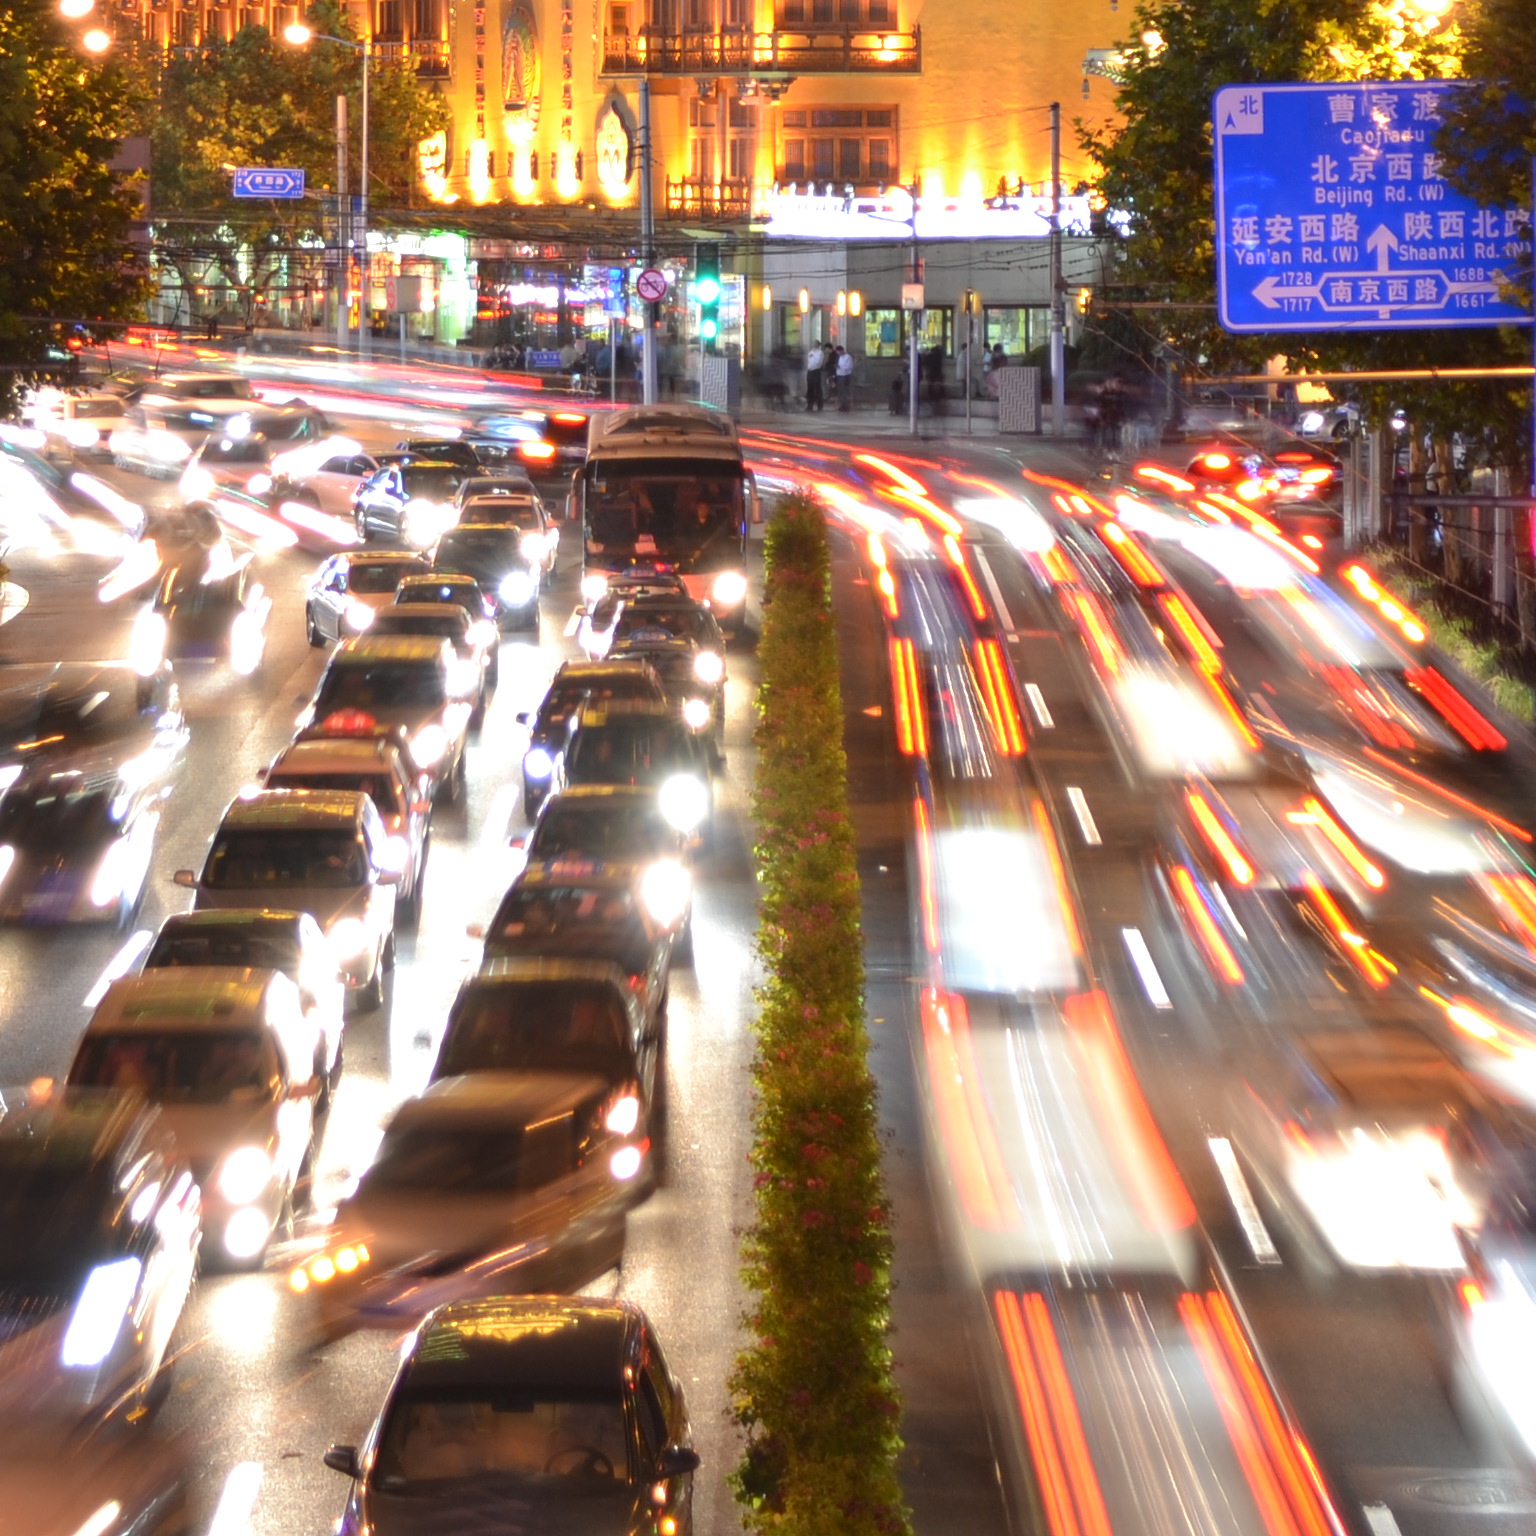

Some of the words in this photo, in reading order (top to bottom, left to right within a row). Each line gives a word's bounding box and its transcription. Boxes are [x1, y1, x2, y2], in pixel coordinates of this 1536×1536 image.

[1239, 95, 1259, 116] 北
[1326, 90, 1442, 123] 曹家渡
[1340, 127, 1425, 148] Caojiadu
[1310, 152, 1448, 184] 北京西路
[1314, 187, 1373, 209] Beijing
[1384, 185, 1413, 202] Rd.
[1231, 211, 1361, 246] 延安西路
[1404, 208, 1533, 242] 陕西北路
[1234, 247, 1292, 266] Yan'an
[1302, 246, 1328, 264] Rd.
[1399, 243, 1465, 262] Shaanxi
[1474, 242, 1500, 260] Rd.
[1282, 271, 1313, 286] 1728
[1454, 267, 1485, 282] 1688
[1329, 278, 1439, 303] 南京西路
[1454, 293, 1486, 309] 1661
[1283, 298, 1312, 312] 1717
